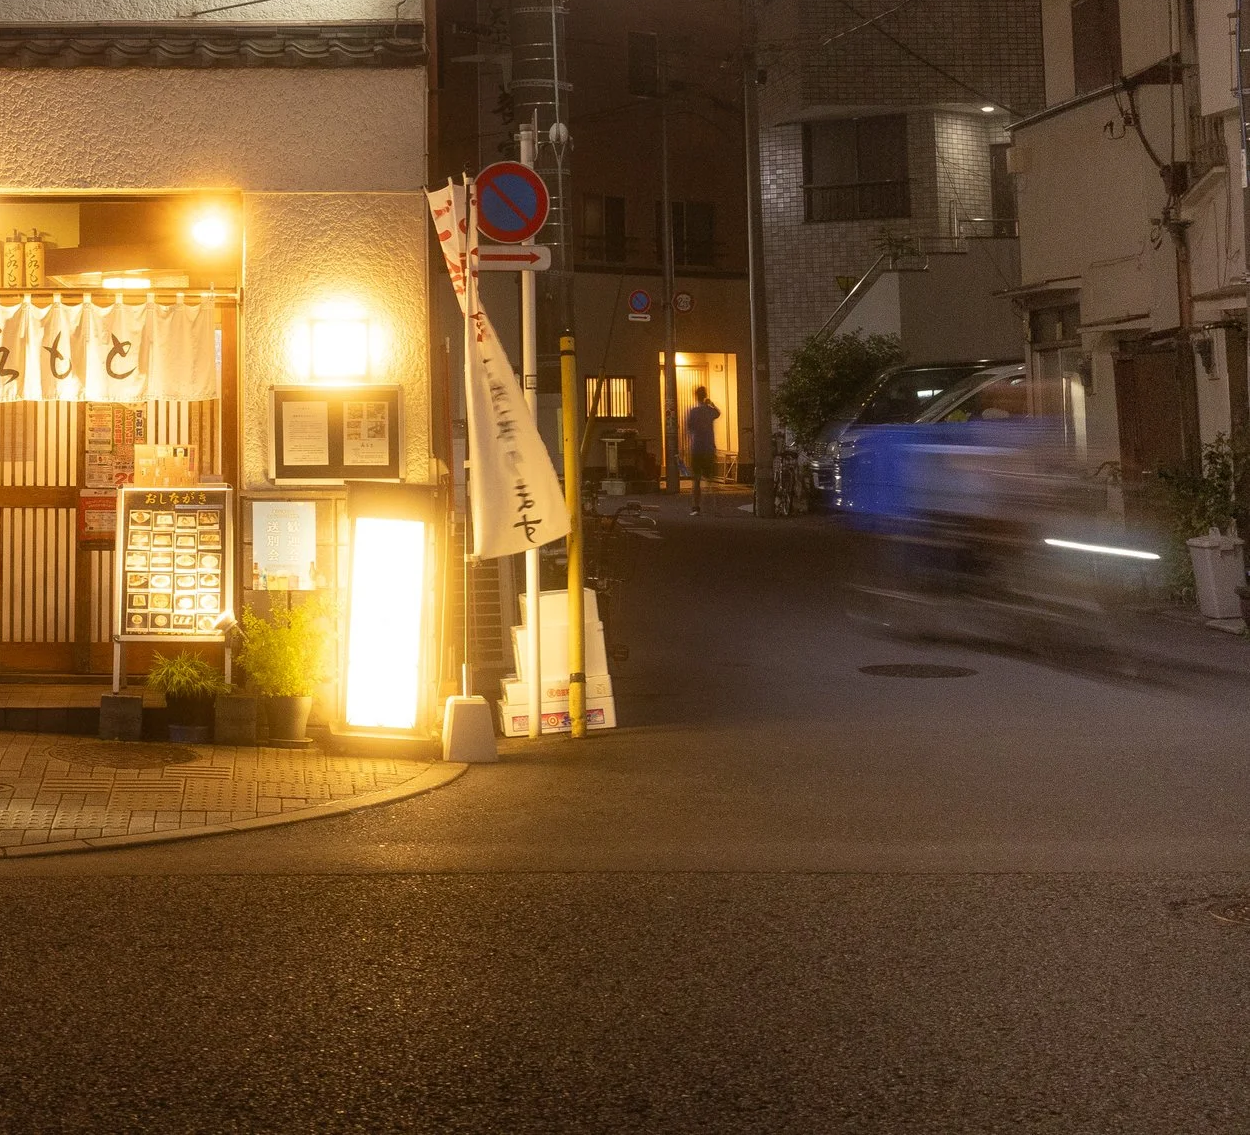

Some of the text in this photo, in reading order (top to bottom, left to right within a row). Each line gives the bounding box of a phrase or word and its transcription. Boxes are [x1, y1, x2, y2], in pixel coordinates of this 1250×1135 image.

[145, 491, 207, 505] おしながき
[266, 520, 282, 562] 送別会
